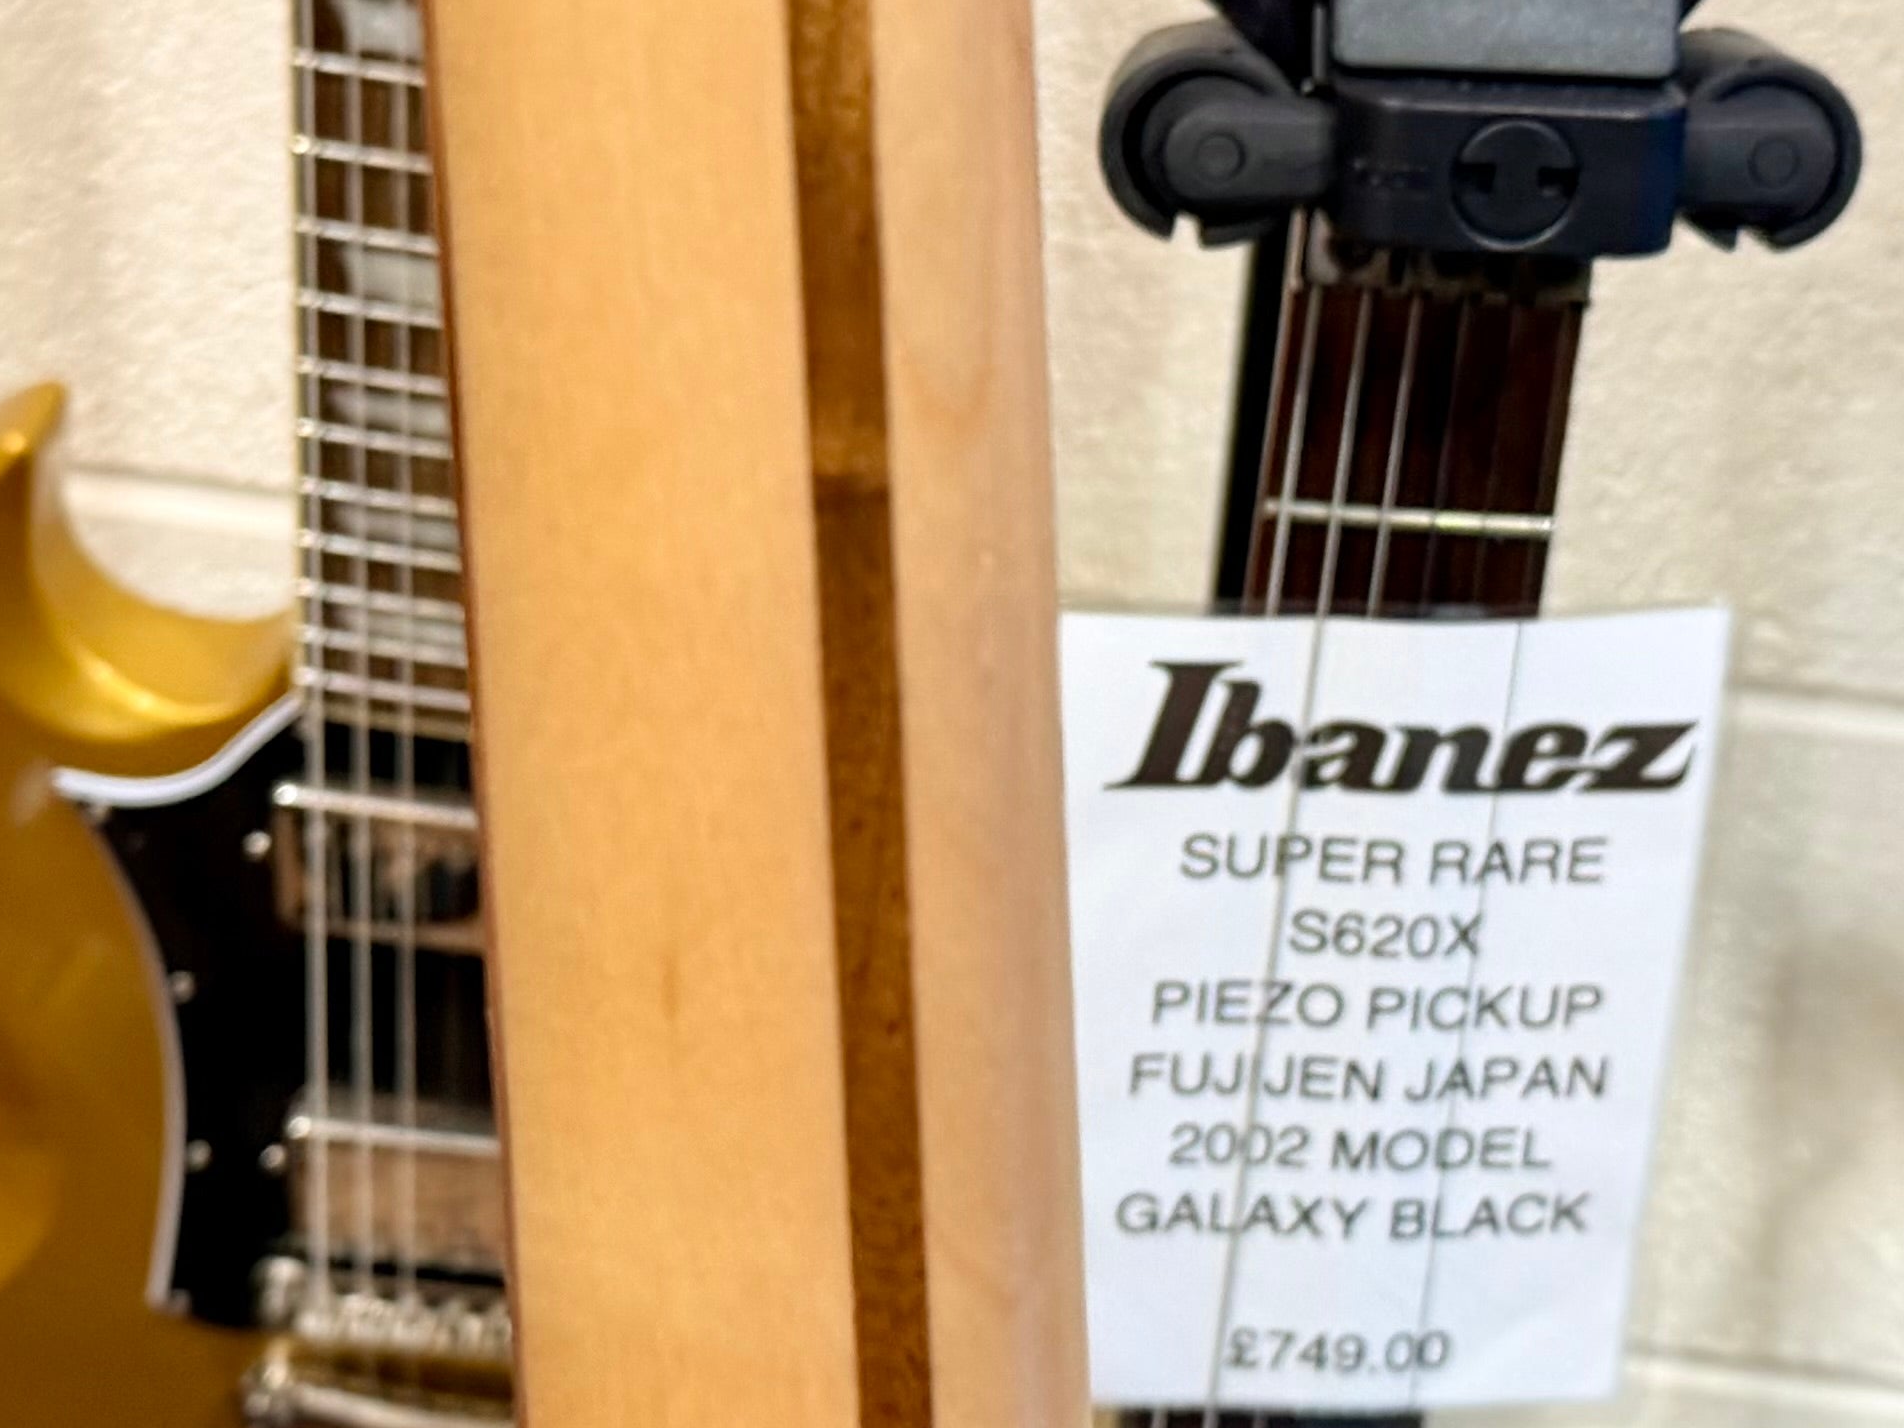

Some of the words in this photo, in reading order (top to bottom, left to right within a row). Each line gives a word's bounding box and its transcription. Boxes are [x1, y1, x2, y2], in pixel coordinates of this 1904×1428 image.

[1103, 658, 1701, 794] Ibanez
[1178, 832, 1405, 885] SUPER
[1430, 836, 1608, 886] RARE
[1289, 909, 1483, 958] S620X
[1151, 979, 1343, 1027] PIEZO
[1366, 984, 1602, 1032] PICKUP
[1405, 1056, 1609, 1102] JAPAN
[1168, 1122, 1310, 1168] 2002
[1331, 1128, 1552, 1171] MODEL
[1116, 1194, 1369, 1240] GALAXY
[1390, 1193, 1591, 1240] BLACK
[1226, 1328, 1450, 1372] £749.00
